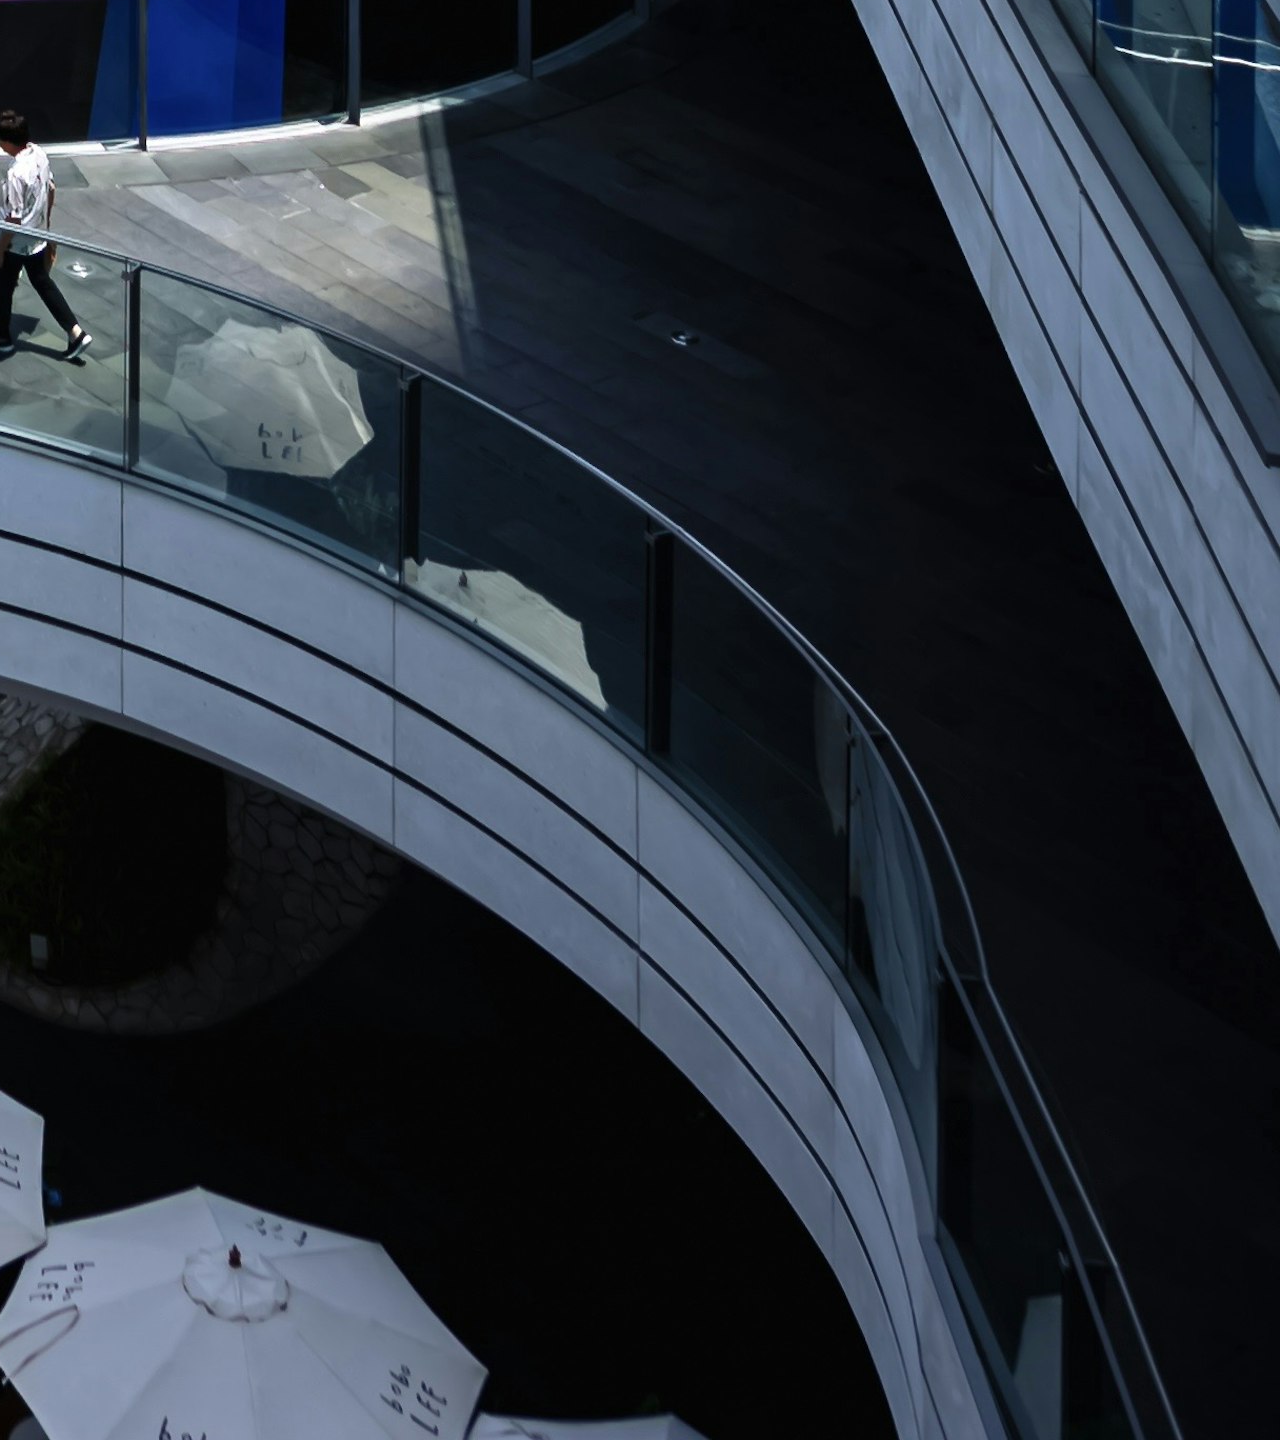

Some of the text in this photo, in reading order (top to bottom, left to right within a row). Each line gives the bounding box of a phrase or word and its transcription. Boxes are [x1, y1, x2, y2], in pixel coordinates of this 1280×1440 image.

[29, 1263, 67, 1302] LEE
[379, 1364, 412, 1414] bobo
[409, 1380, 448, 1437] LEE
